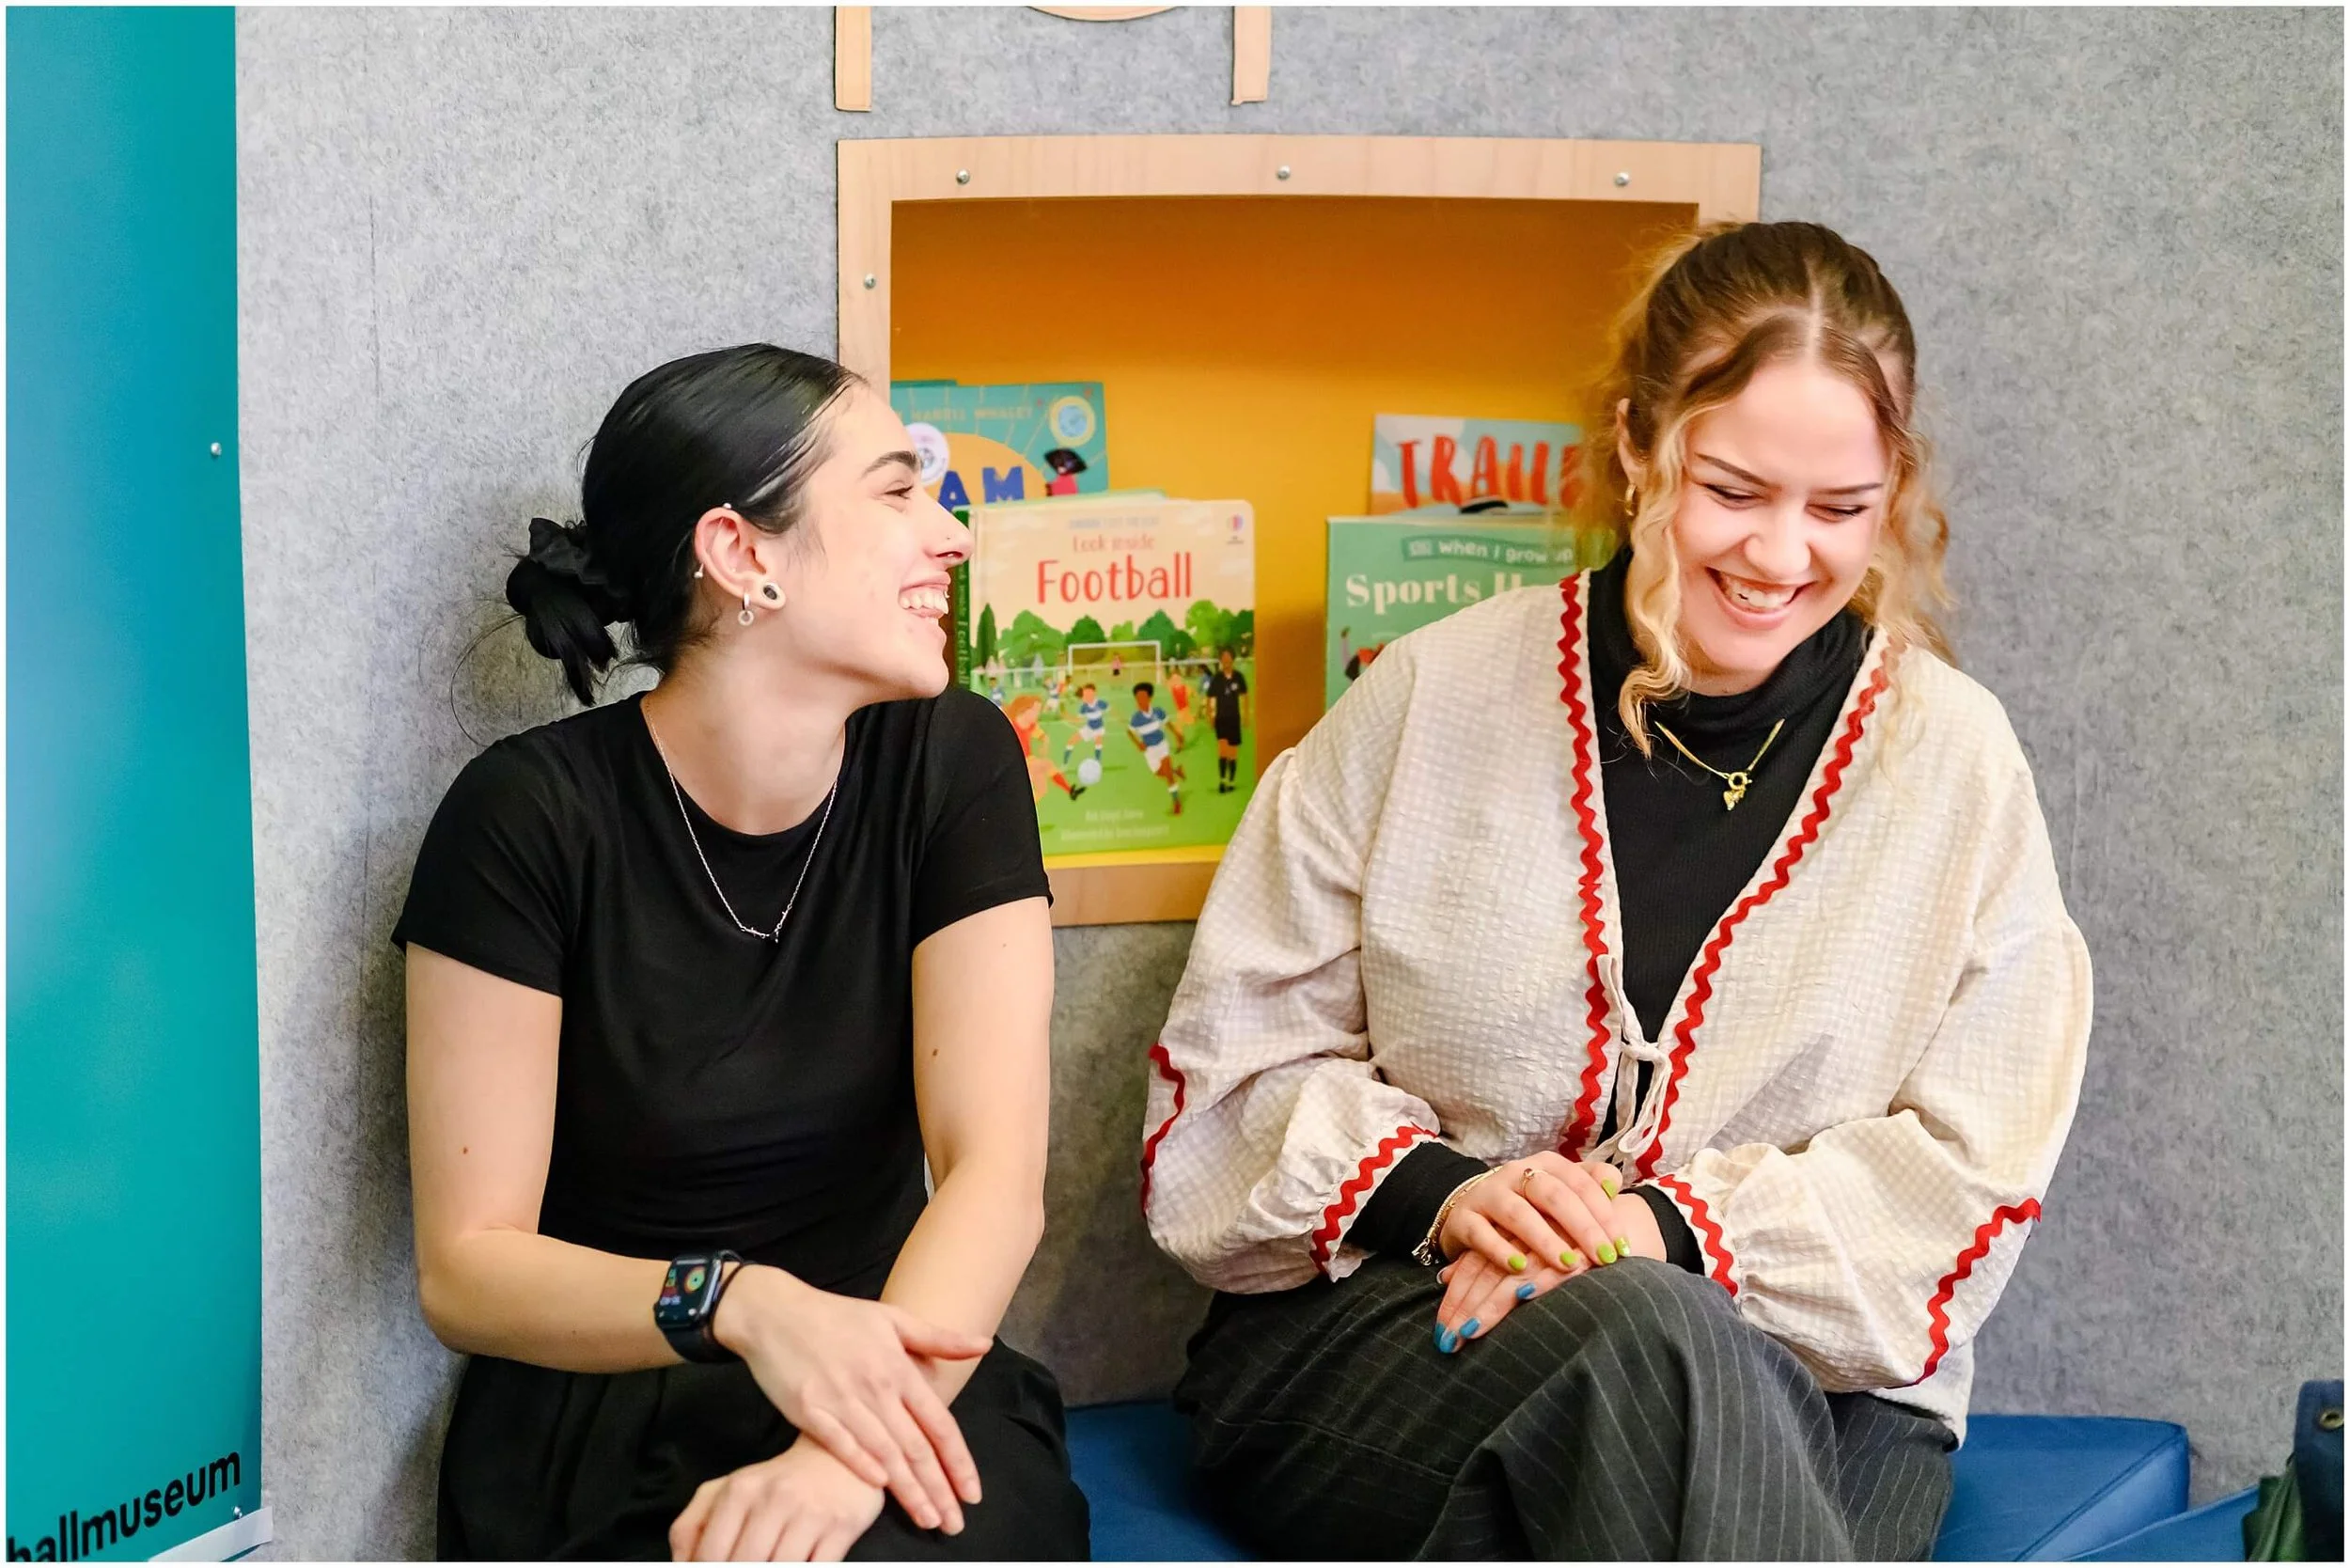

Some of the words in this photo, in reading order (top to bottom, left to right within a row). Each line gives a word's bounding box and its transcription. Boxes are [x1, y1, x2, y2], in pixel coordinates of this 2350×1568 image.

[1073, 533, 1105, 553] Look
[1111, 533, 1155, 552] inside
[1439, 540, 1488, 557] when
[1506, 548, 1547, 564] grow
[1038, 551, 1192, 604] Football
[1346, 573, 1482, 615] Sports
